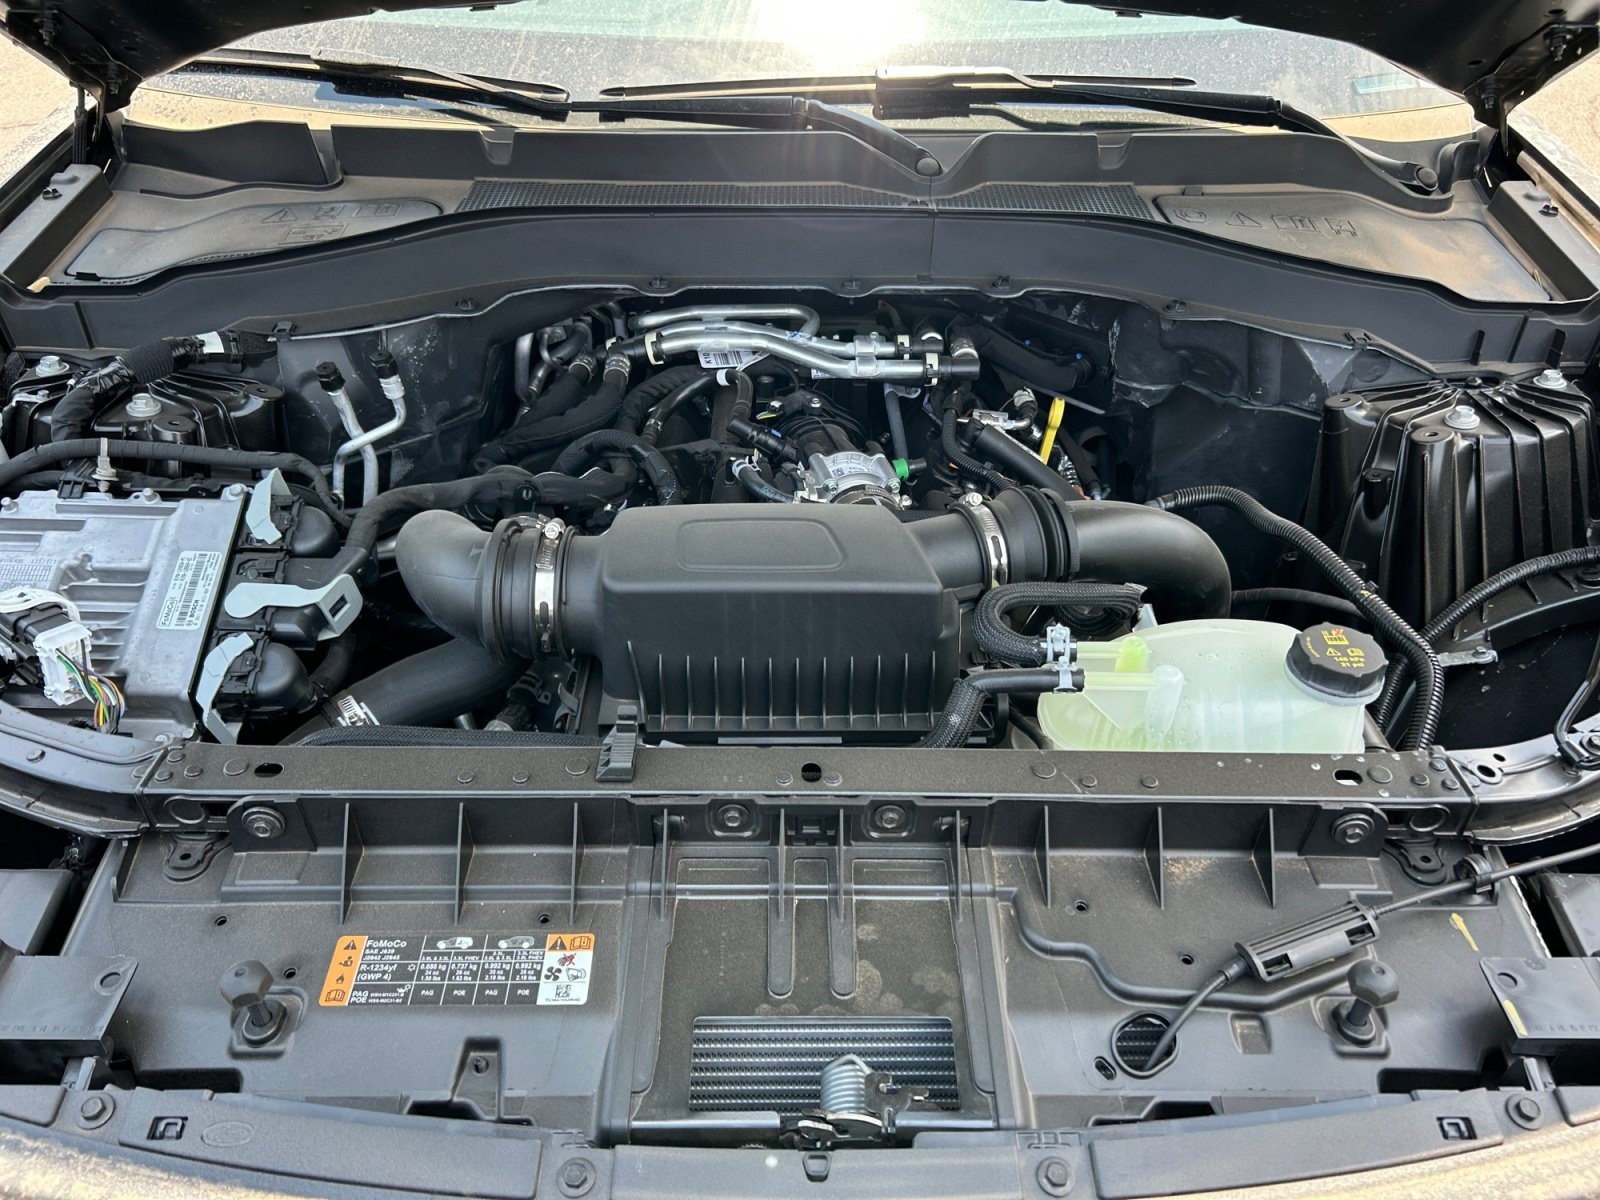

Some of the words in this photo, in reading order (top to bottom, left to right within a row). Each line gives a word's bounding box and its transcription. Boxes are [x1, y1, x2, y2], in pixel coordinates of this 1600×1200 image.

[162, 600, 174, 625] FoMoCo
[189, 600, 200, 617] BOSCH
[366, 940, 407, 948] FoMoCo
[360, 964, 398, 972] R-1234yf
